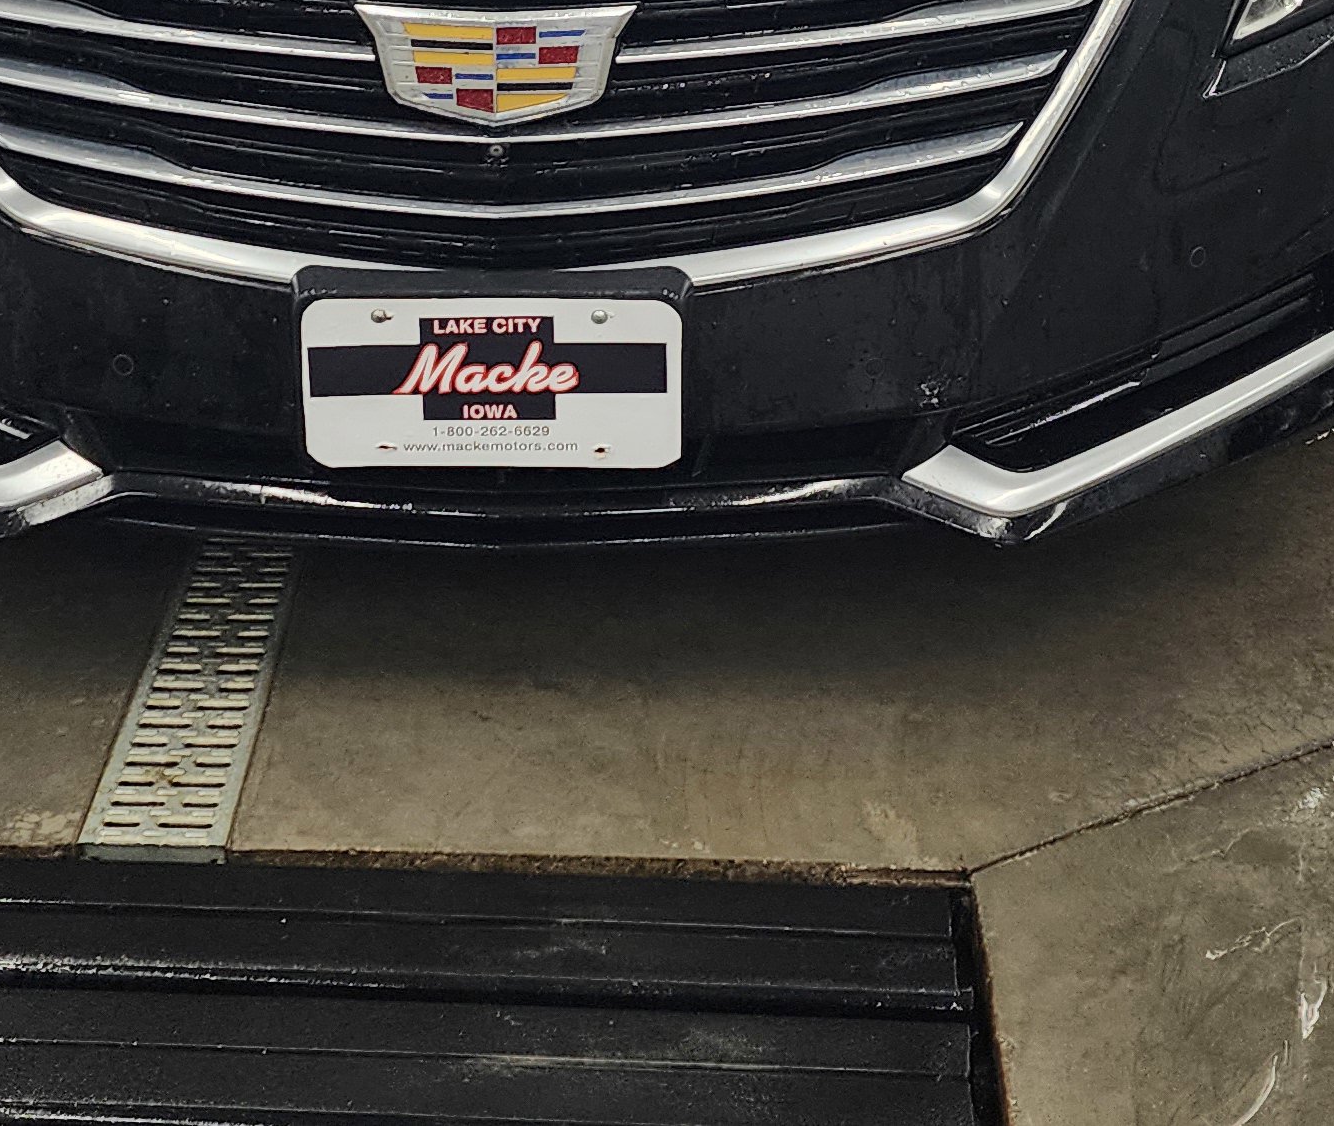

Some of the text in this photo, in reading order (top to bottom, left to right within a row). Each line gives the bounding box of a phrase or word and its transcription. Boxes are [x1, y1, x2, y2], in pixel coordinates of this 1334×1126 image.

[433, 318, 542, 335] LAKE CITY
[392, 340, 580, 395] Macke
[463, 404, 517, 419] IOWA
[432, 426, 550, 437] 1-800-262-6629
[403, 441, 578, 452] www.mackemotors.com
